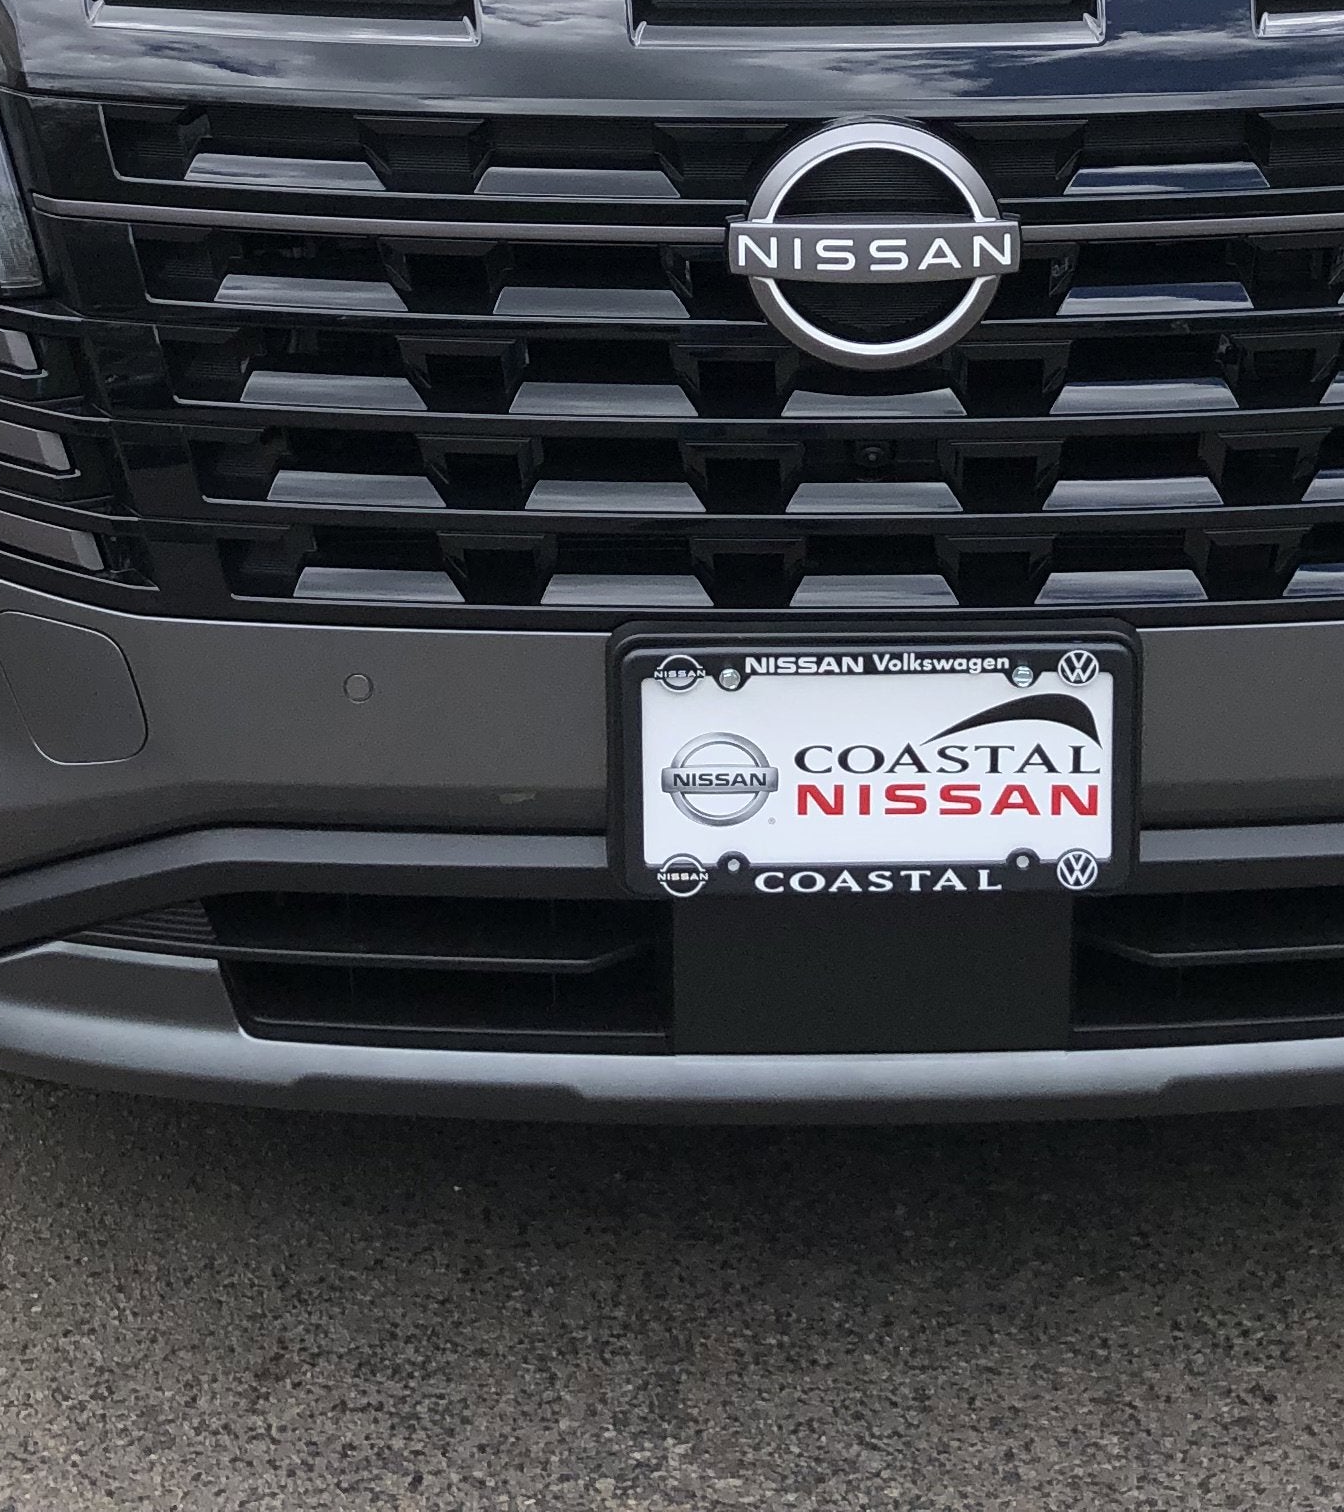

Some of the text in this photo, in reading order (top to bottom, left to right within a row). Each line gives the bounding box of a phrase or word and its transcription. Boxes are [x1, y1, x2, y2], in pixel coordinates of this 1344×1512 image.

[737, 233, 1012, 271] NISSAN
[653, 669, 706, 678] NISSAN
[745, 653, 1010, 674] NISSAN Volkswagen
[794, 742, 1102, 775] COASTAL
[672, 772, 767, 788] NISSAN
[796, 783, 1099, 817] NISSAN
[657, 872, 709, 881] NISSAN
[754, 869, 1003, 893] COASTAL
